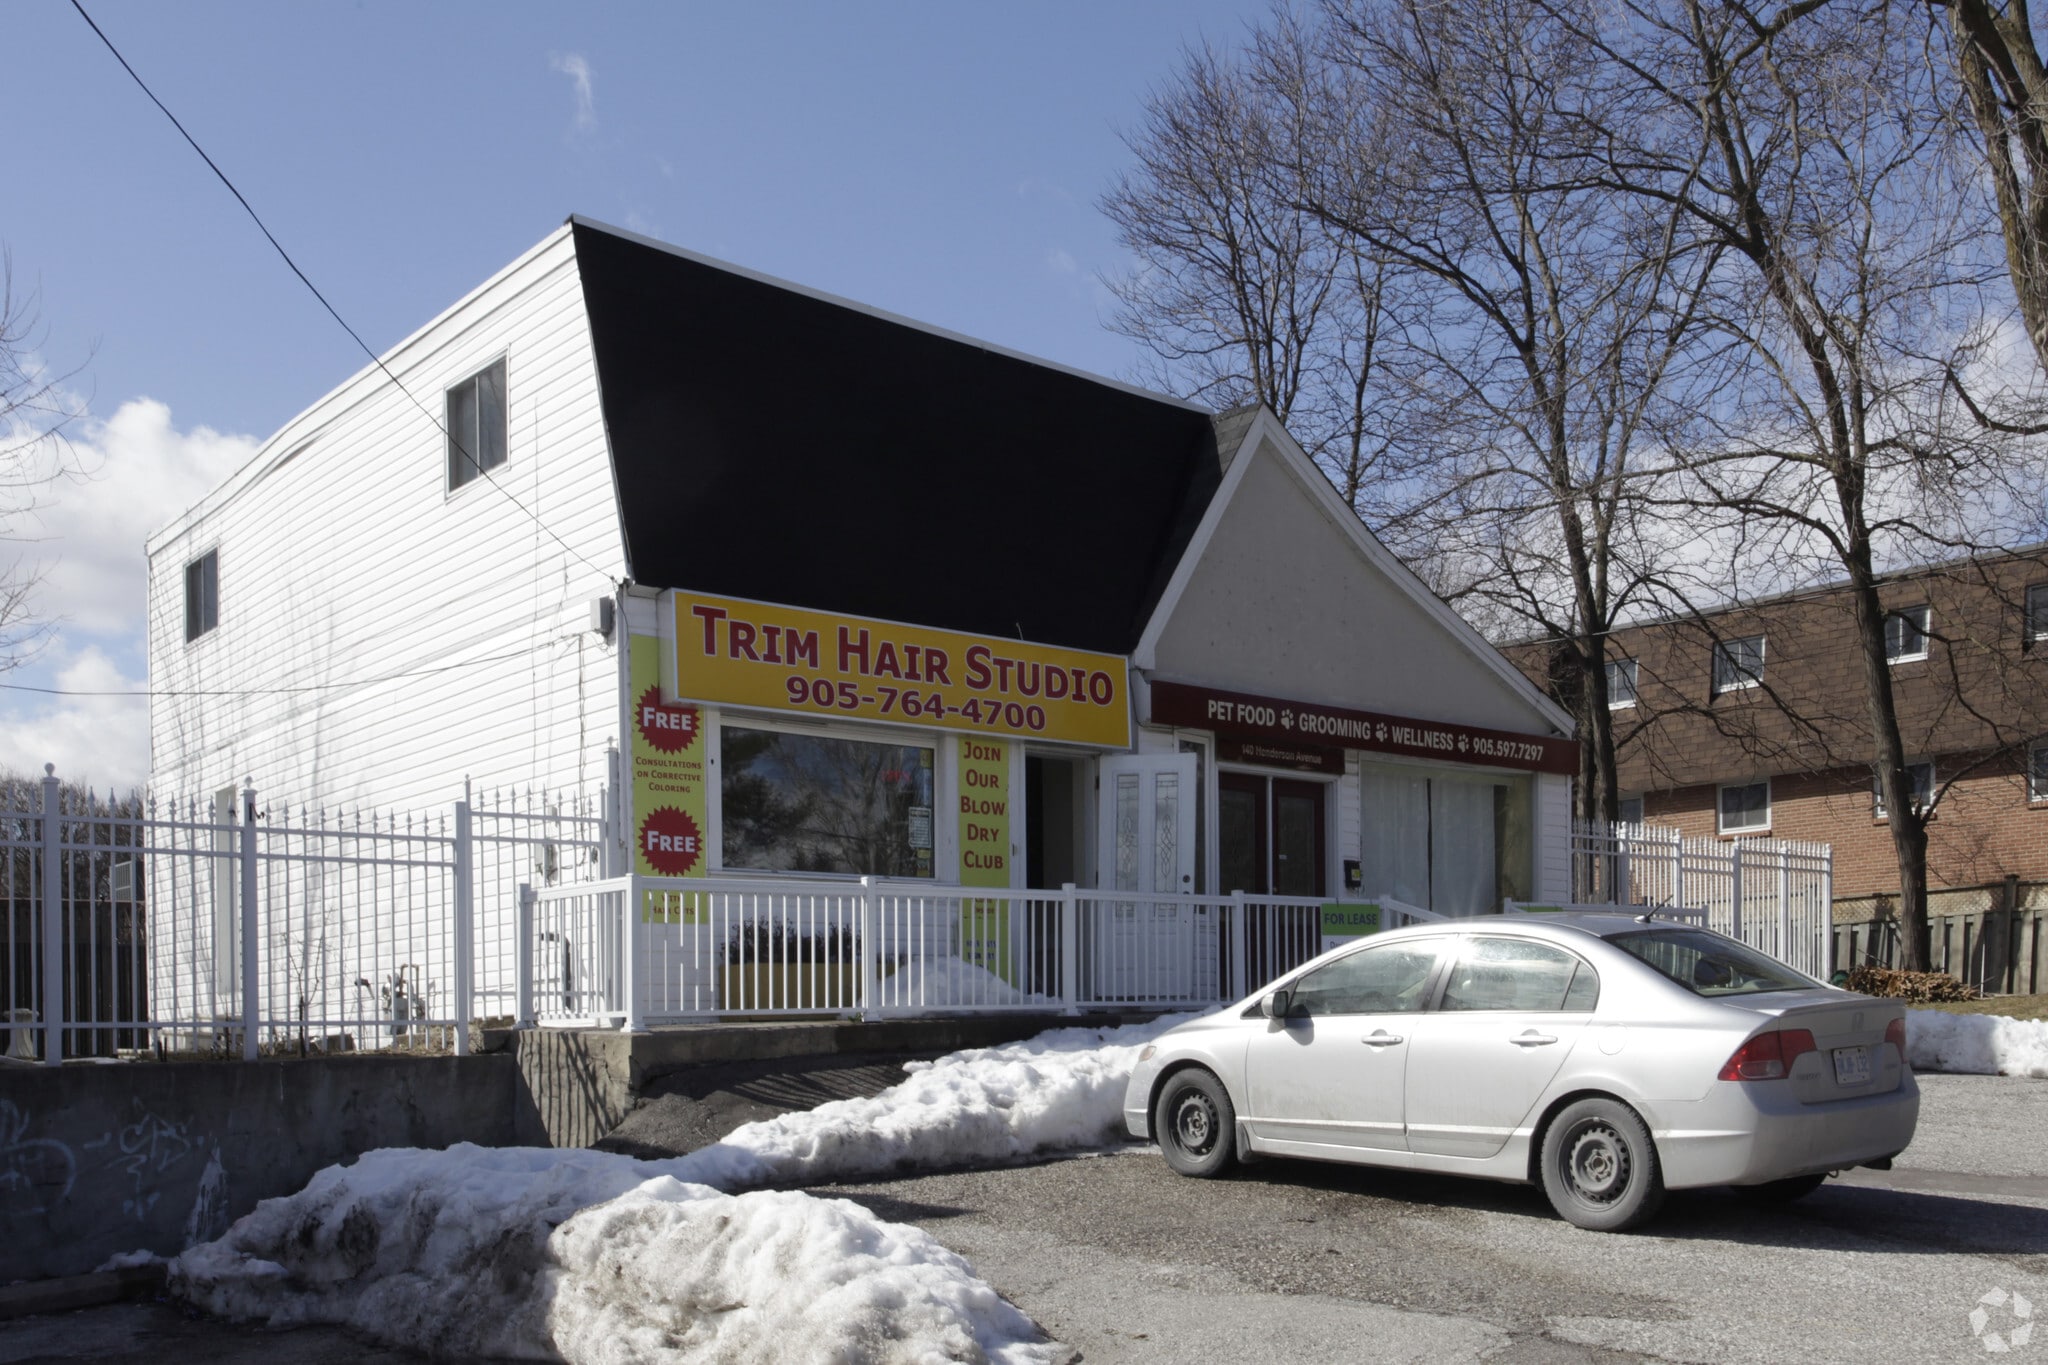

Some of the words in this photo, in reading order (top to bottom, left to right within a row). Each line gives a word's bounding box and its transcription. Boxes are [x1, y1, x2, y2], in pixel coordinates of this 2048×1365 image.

[692, 604, 819, 669] TRIM
[838, 625, 952, 686] HAIR
[965, 645, 1114, 706] STUDIO
[786, 676, 1046, 731] 905-764-4700
[643, 706, 692, 731] FREE
[1208, 700, 1234, 721] PET
[1237, 704, 1275, 726] FOOD
[1299, 713, 1371, 740] GROOMING
[1392, 726, 1454, 750] WELLNESS
[1473, 737, 1544, 761] 905.597.7297
[963, 742, 1001, 761] JOIN
[1242, 744, 1254, 756] 140
[1255, 745, 1295, 761] Henderson
[1296, 752, 1322, 764] Avenue
[635, 756, 702, 770] CONSULTATIONS
[651, 769, 701, 782] CORRECTIVE
[966, 769, 999, 788] OUR
[648, 782, 691, 794] COLORING
[960, 796, 1005, 816] BLOW
[647, 830, 696, 853] FREE
[967, 823, 999, 842] DRY
[964, 850, 1003, 869] CLUB
[673, 905, 695, 915] CTS
[1324, 913, 1345, 925] FOR
[1347, 913, 1377, 925] LEASE
